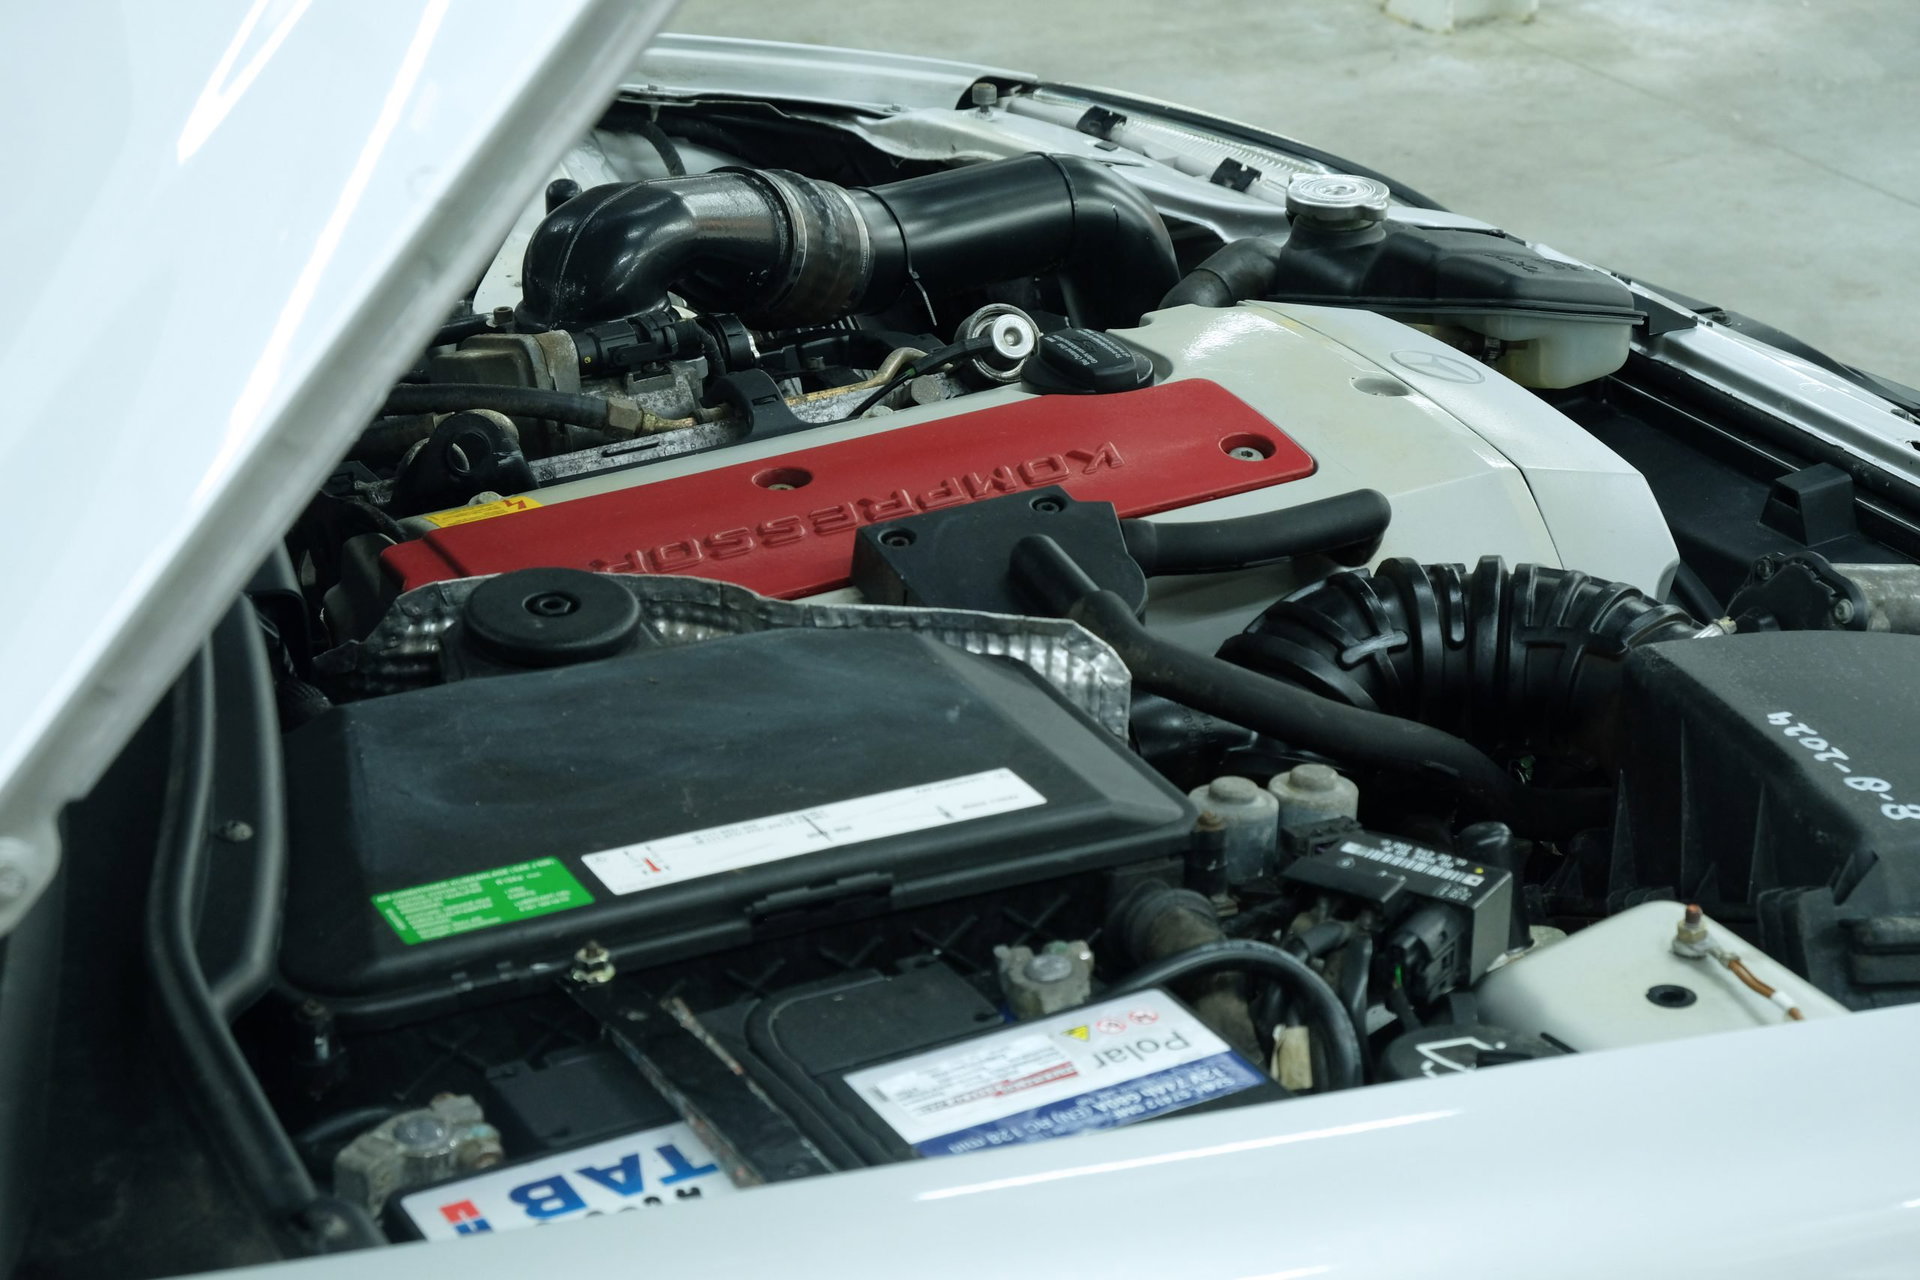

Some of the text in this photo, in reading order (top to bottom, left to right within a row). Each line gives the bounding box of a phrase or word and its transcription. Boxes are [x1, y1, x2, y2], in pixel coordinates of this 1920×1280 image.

[591, 441, 1128, 574] KOMPRESSOR
[1092, 1029, 1191, 1070] Polar
[985, 1125, 1020, 1146] 128
[1022, 1114, 1051, 1132] RC
[508, 1143, 721, 1220] TAB
